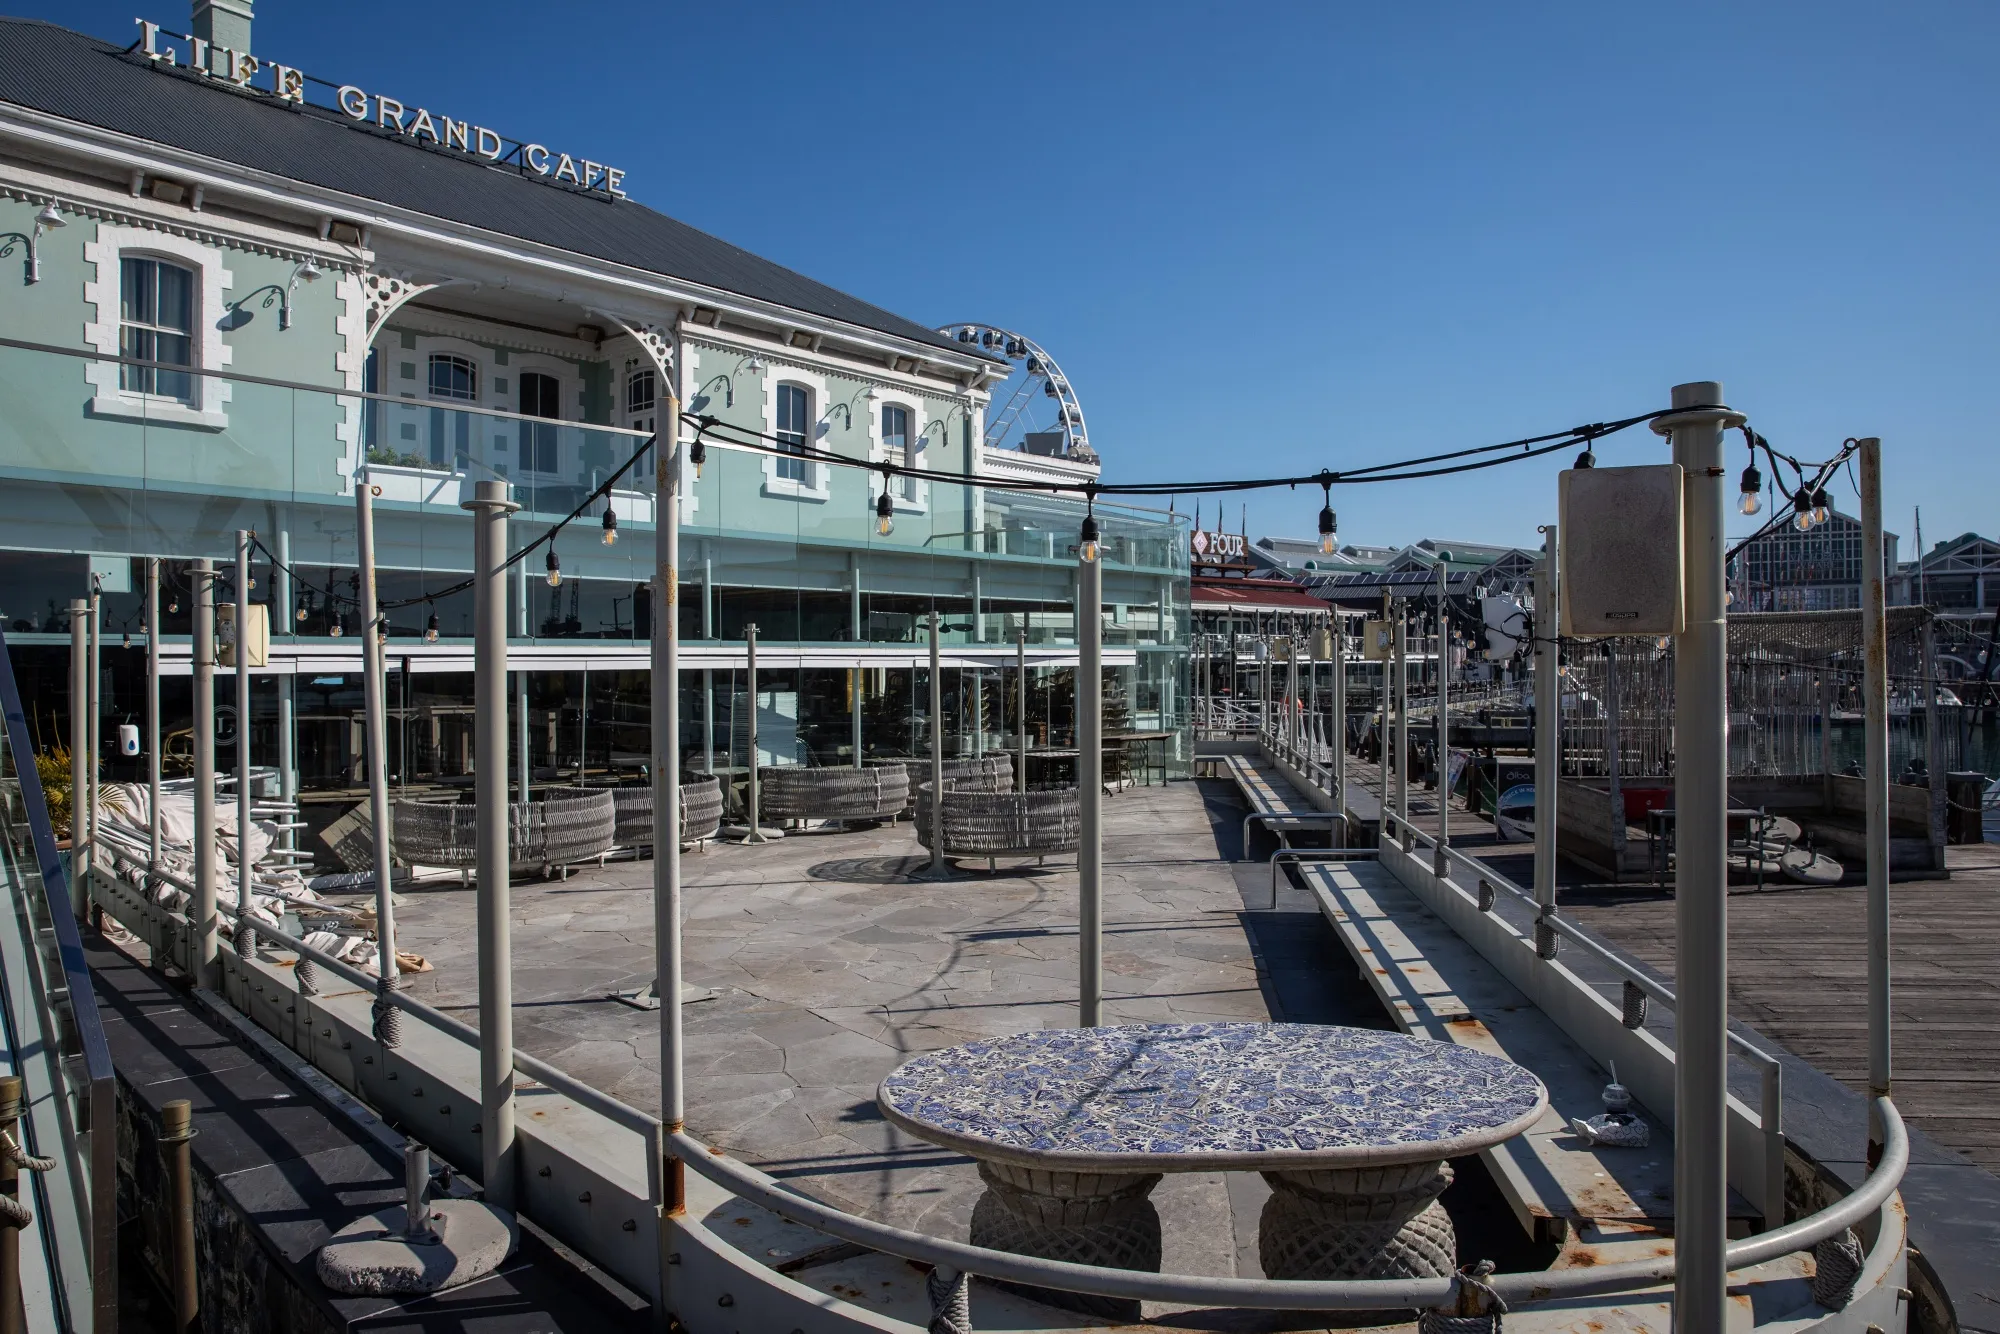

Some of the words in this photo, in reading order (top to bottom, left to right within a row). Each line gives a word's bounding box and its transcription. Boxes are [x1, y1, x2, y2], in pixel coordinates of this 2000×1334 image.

[135, 18, 303, 104] LIFE
[337, 86, 502, 160] GRAND
[524, 144, 627, 198] CAFE
[1210, 533, 1244, 556] FOUR
